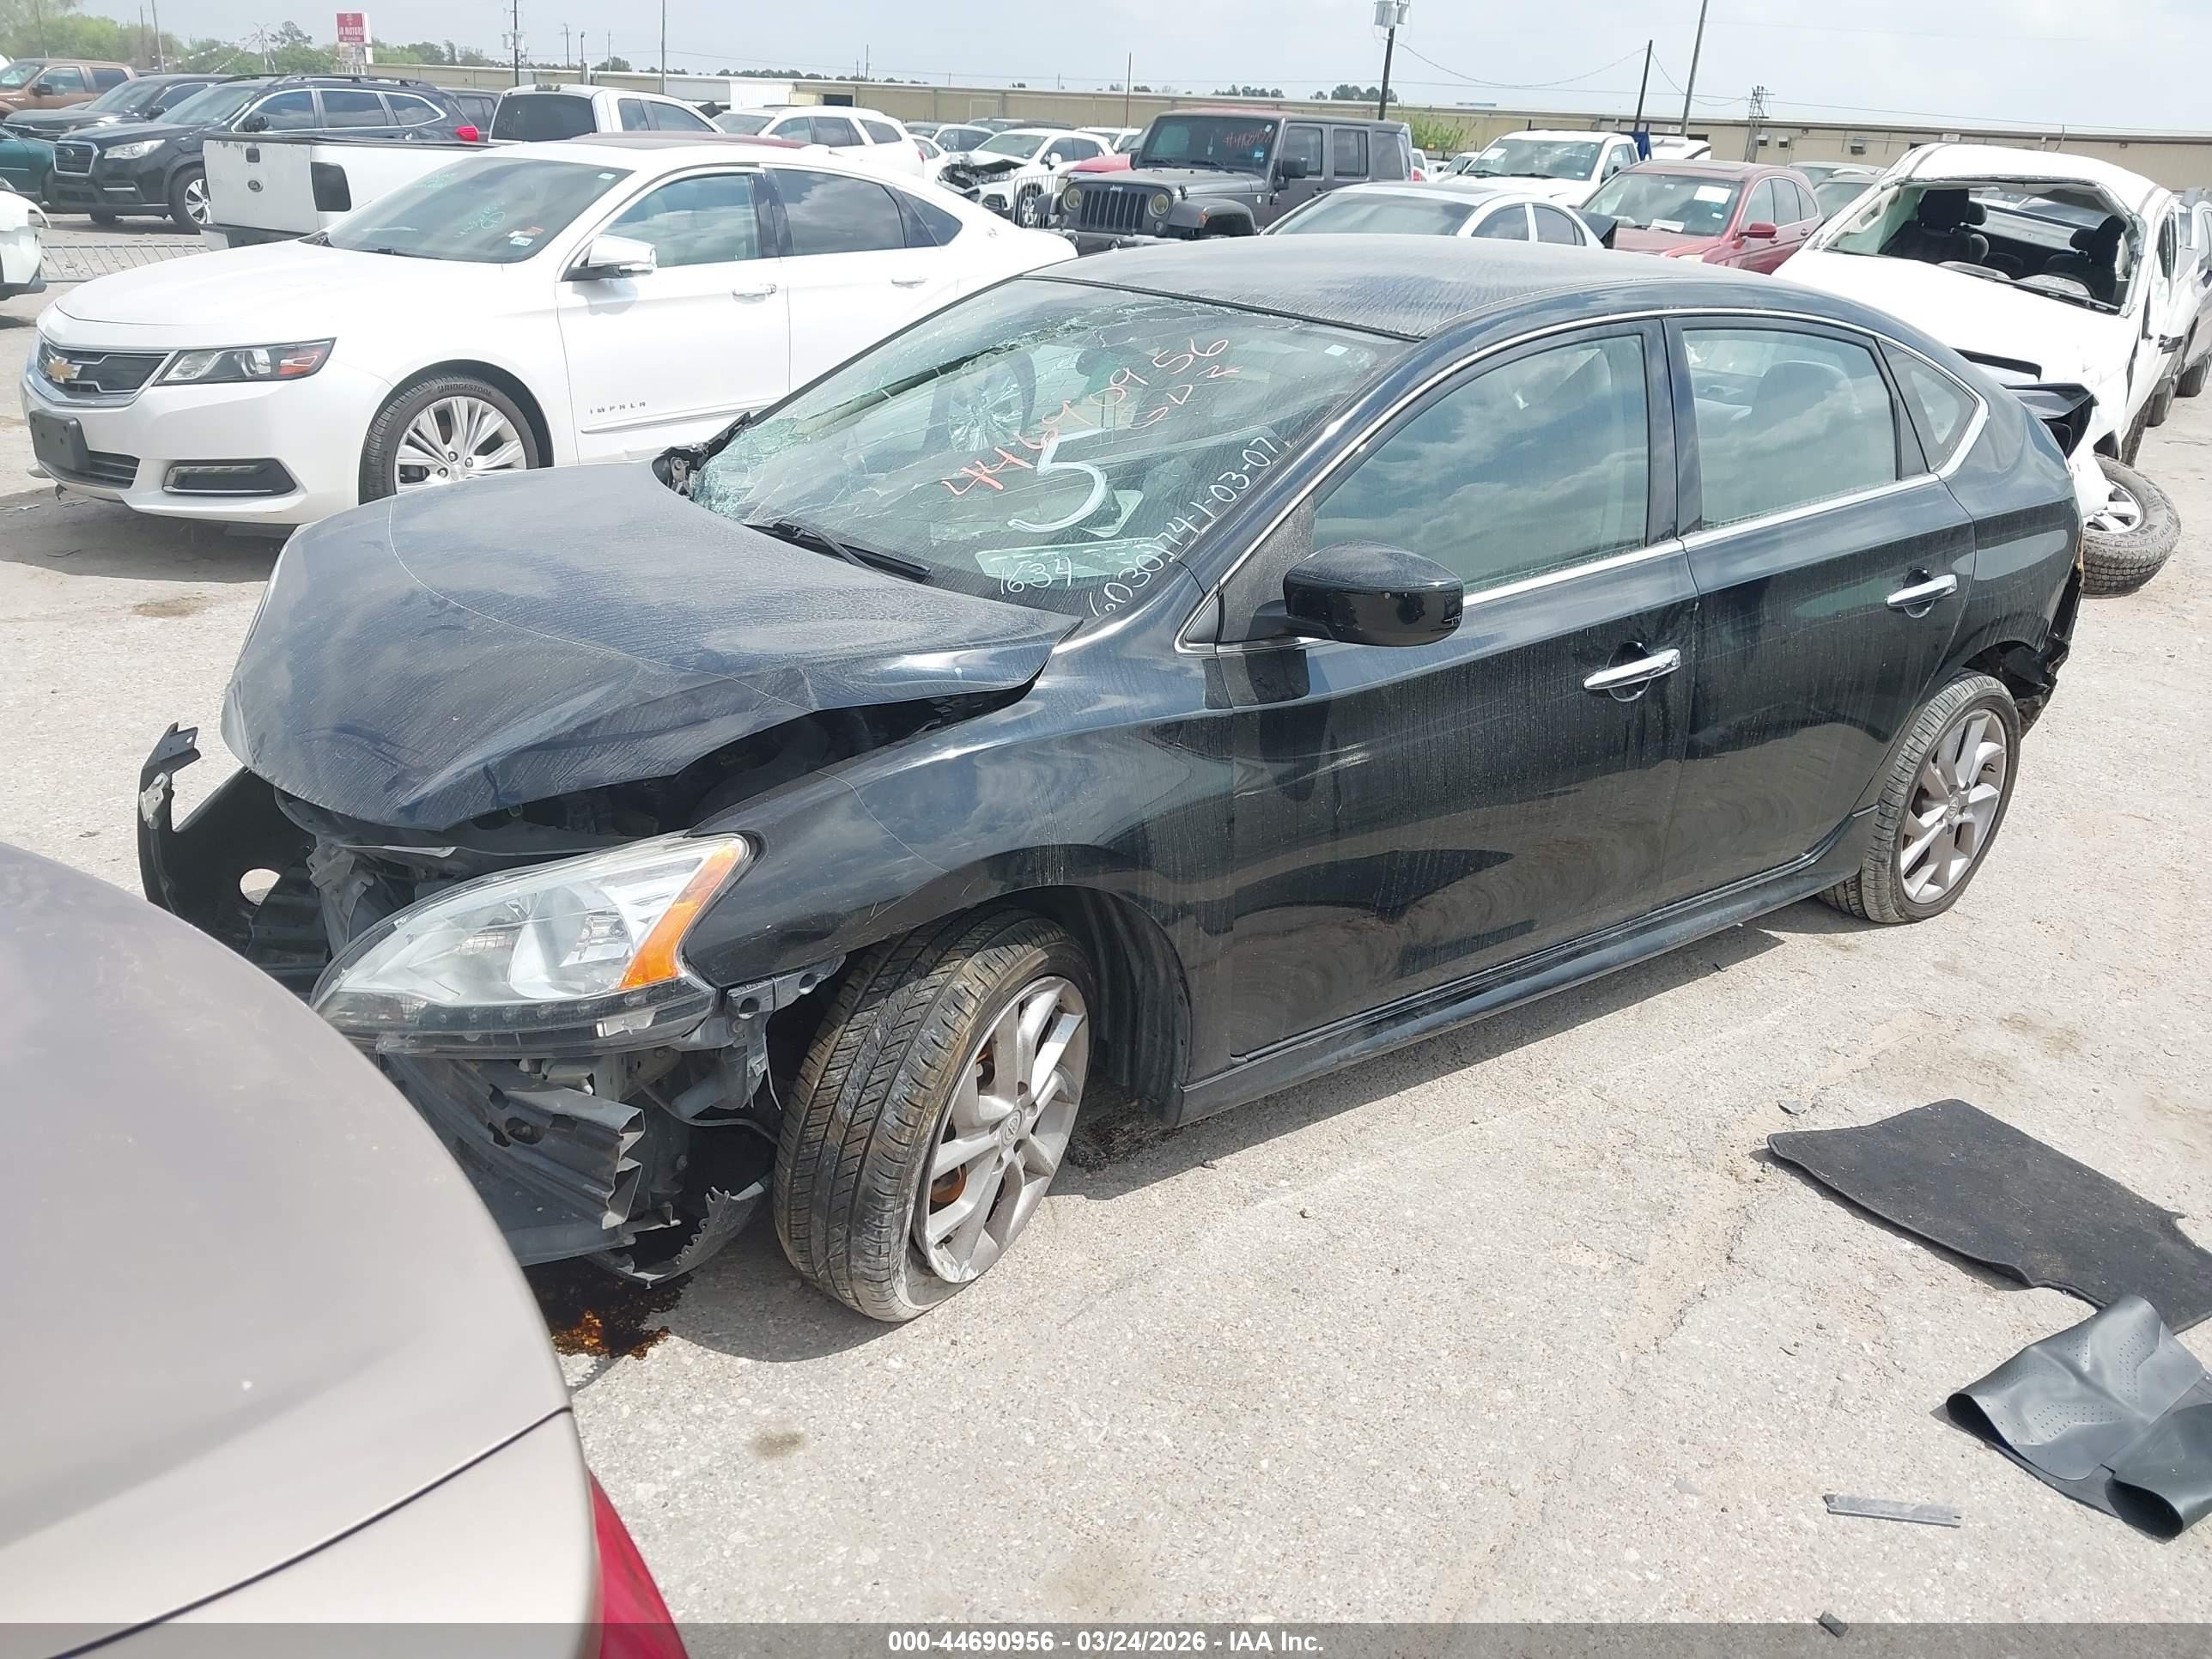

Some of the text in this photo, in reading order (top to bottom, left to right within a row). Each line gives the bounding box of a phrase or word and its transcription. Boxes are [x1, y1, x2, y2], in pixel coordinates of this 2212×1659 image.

[590, 401, 646, 414] IMPALA
[1007, 427, 1108, 533] 5
[1000, 556, 1073, 594] 1634
